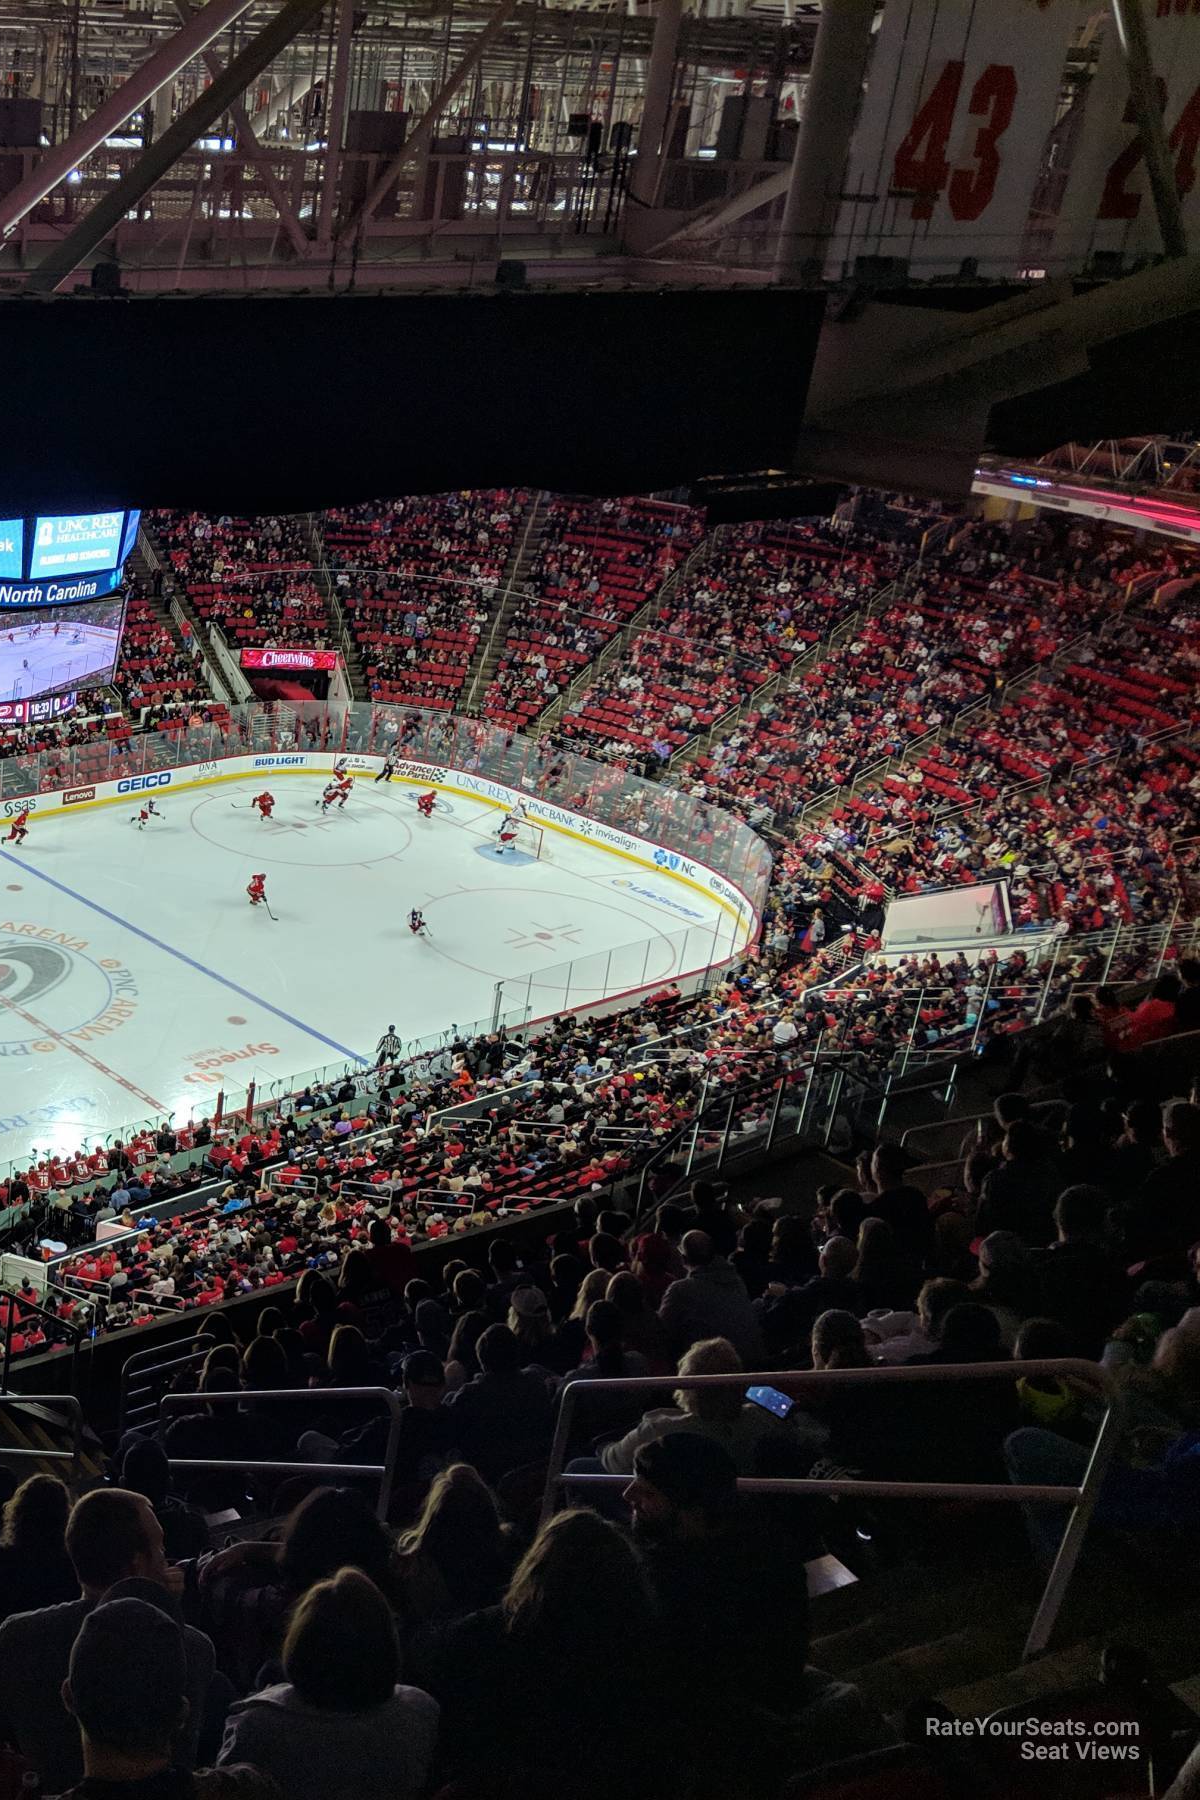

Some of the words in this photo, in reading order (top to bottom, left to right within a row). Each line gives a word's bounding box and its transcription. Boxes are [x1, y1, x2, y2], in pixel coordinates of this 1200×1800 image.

[893, 60, 1018, 221] 43
[58, 518, 90, 533] UNC
[92, 515, 120, 529] REX
[56, 528, 119, 543] HEALTHCARE
[0, 585, 43, 603] North
[46, 580, 97, 602] Carolina
[262, 651, 314, 667] Cheerwine
[254, 757, 274, 766] BUD
[276, 755, 305, 766] LIGHT
[394, 761, 432, 774] Advance
[117, 772, 171, 793] GEICO
[407, 771, 429, 780] Parts
[65, 790, 93, 802] Lenovo
[456, 774, 485, 792] UNC
[488, 784, 513, 803] REX
[595, 826, 637, 851] invisalign
[681, 861, 697, 877] NC
[0, 921, 89, 951] ARENA
[108, 969, 138, 996] PNC
[68, 998, 138, 1041] ARENA
[193, 1042, 280, 1070] Syneos
